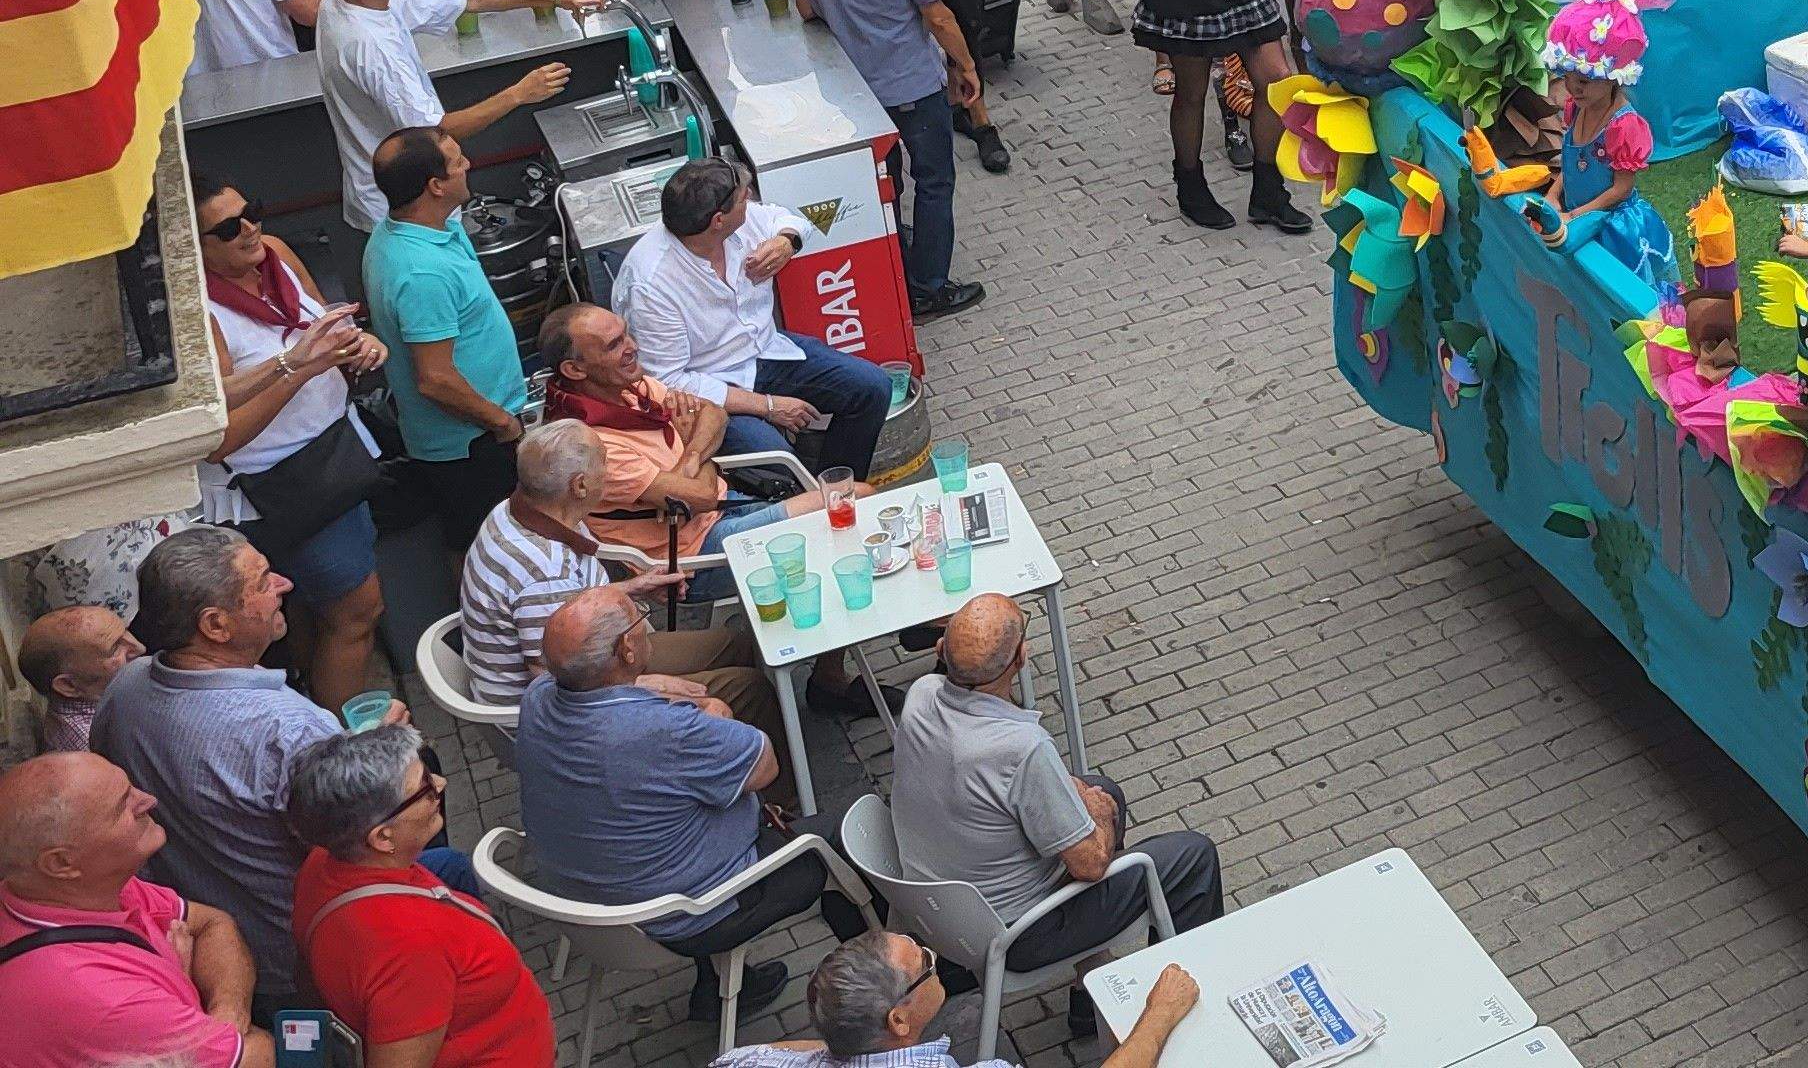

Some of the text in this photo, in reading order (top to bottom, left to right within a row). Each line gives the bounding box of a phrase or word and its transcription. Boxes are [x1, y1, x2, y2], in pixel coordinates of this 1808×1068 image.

[806, 201, 837, 215] 1900
[816, 258, 867, 354] BAR
[1514, 264, 1734, 620] Trolls
[1104, 973, 1131, 1004] AMBAR
